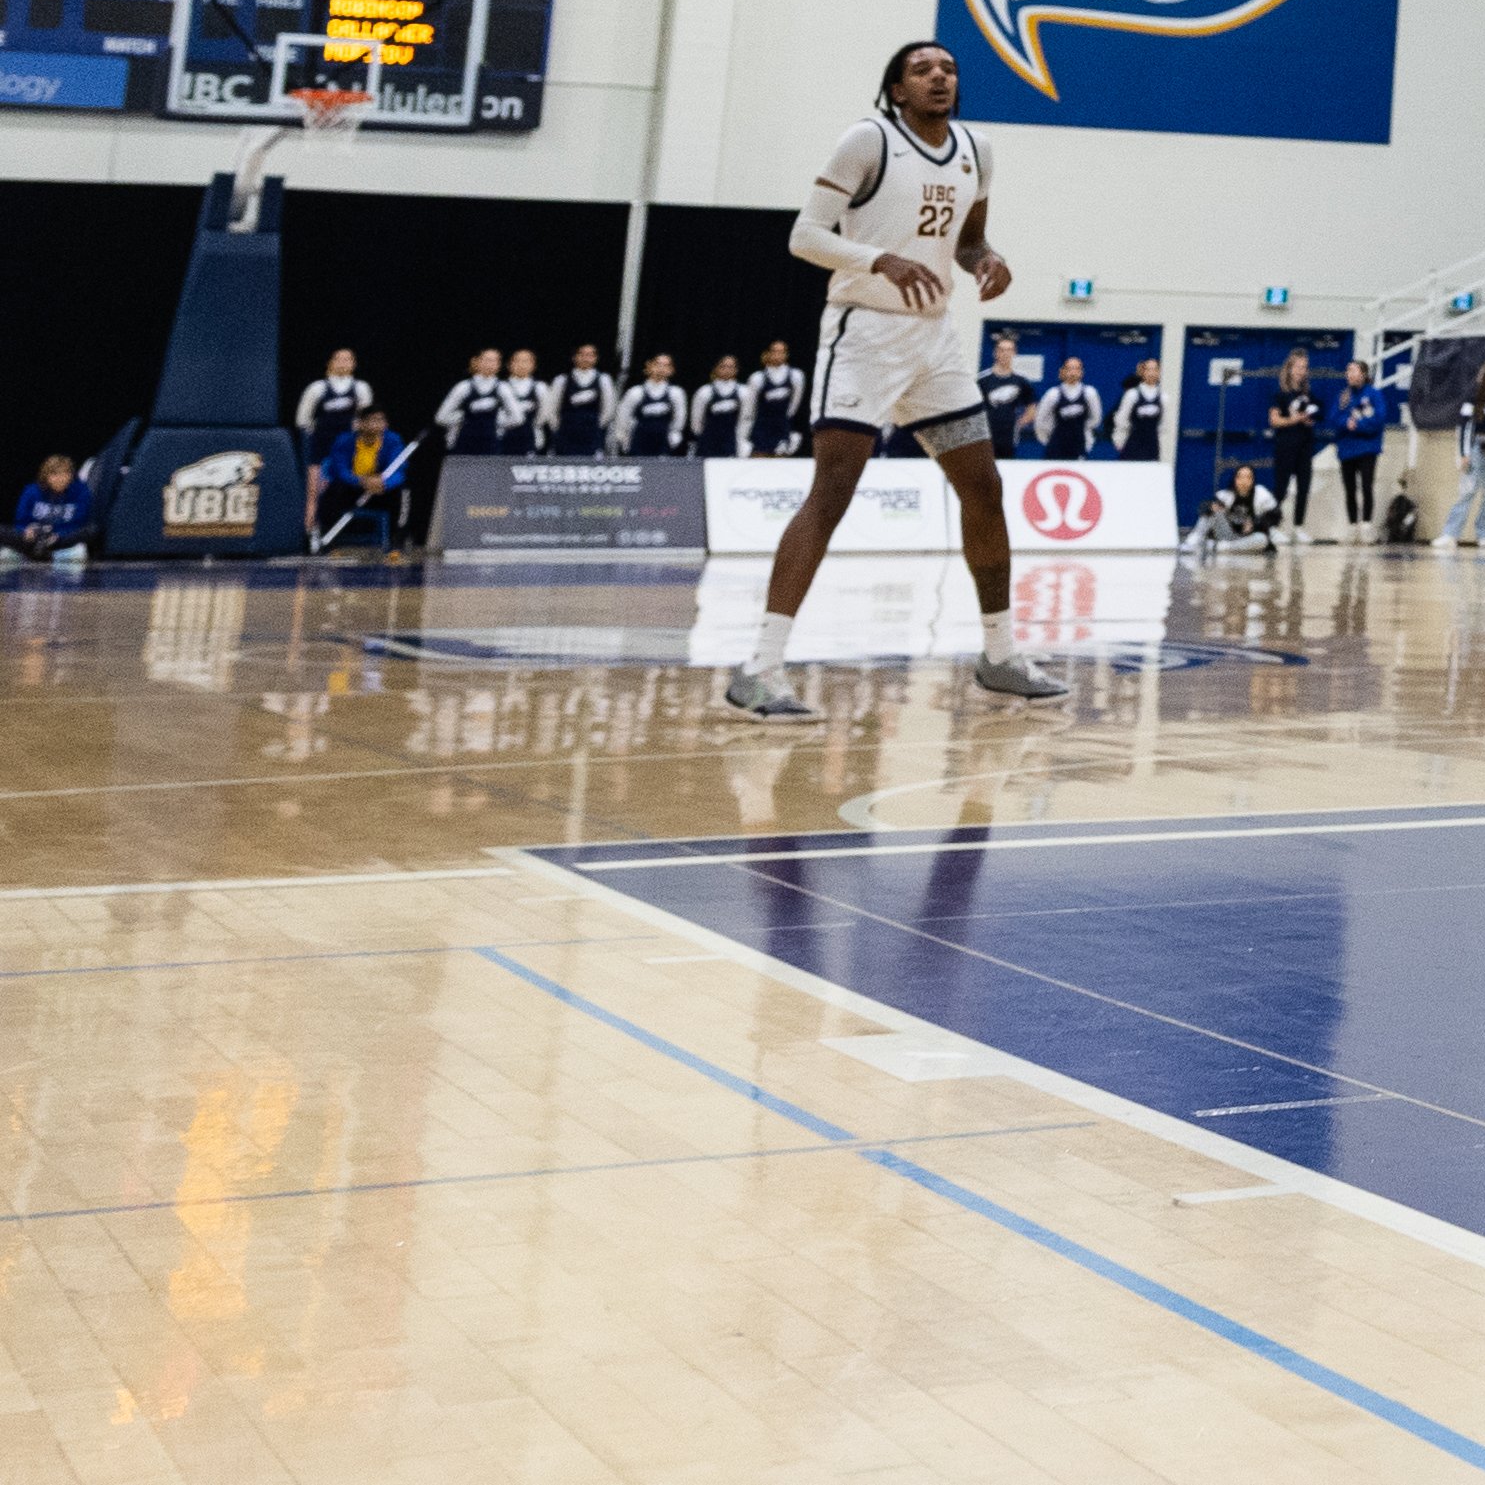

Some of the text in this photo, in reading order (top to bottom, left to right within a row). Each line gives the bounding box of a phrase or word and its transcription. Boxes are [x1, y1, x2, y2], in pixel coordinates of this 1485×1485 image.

[922, 183, 956, 203] UBC
[918, 204, 955, 237] 22
[163, 484, 260, 526] UBC
